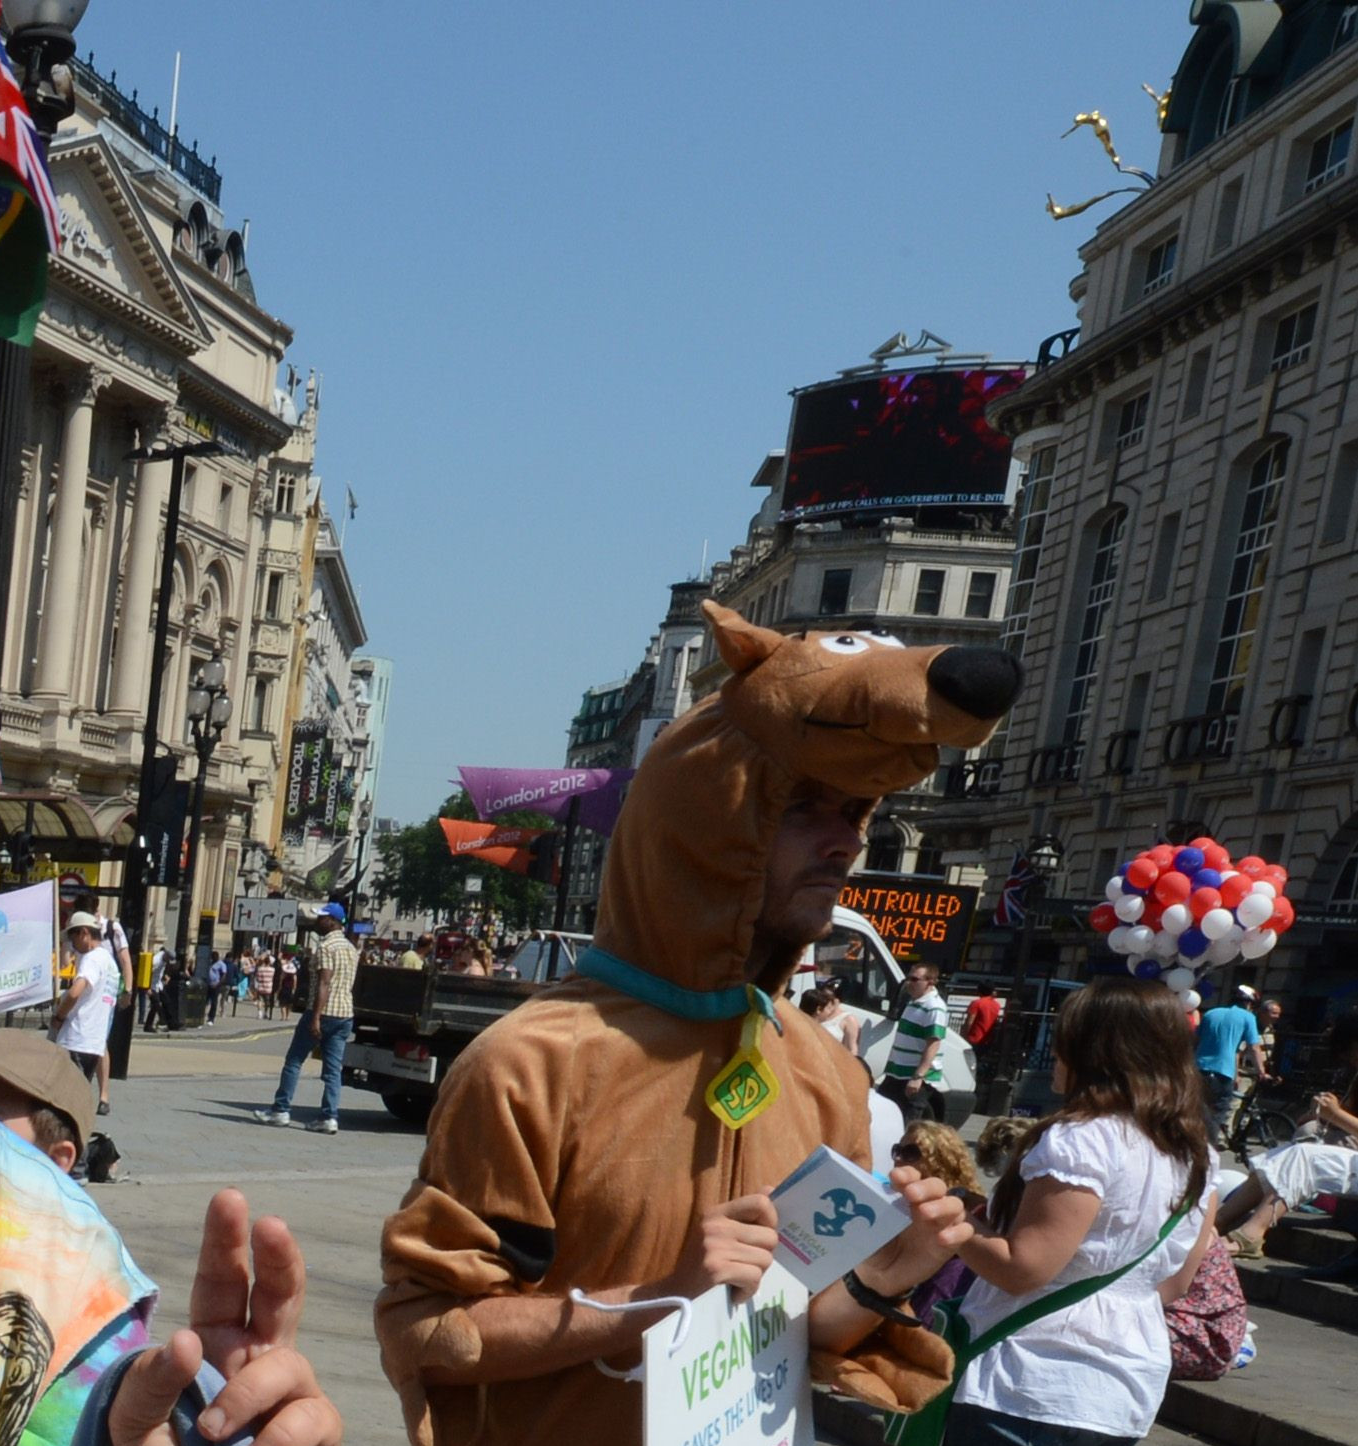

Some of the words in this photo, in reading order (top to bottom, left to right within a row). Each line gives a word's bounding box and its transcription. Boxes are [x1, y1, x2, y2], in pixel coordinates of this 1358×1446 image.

[855, 497, 878, 507] CALLS
[880, 496, 893, 505] ON
[894, 494, 954, 505] GOVERNMENT
[957, 493, 969, 502] TO
[288, 742, 306, 816] TROCADERO
[486, 787, 545, 813] London
[549, 773, 587, 795] 2012
[456, 837, 496, 852] London
[838, 885, 963, 917] ONTROLLED
[865, 913, 948, 943] NKING
[726, 1074, 761, 1110] SD
[681, 1288, 787, 1411] VEGANISM
[725, 1402, 744, 1436] THE
[746, 1378, 775, 1426] LIVES
[776, 1357, 789, 1391] OF
